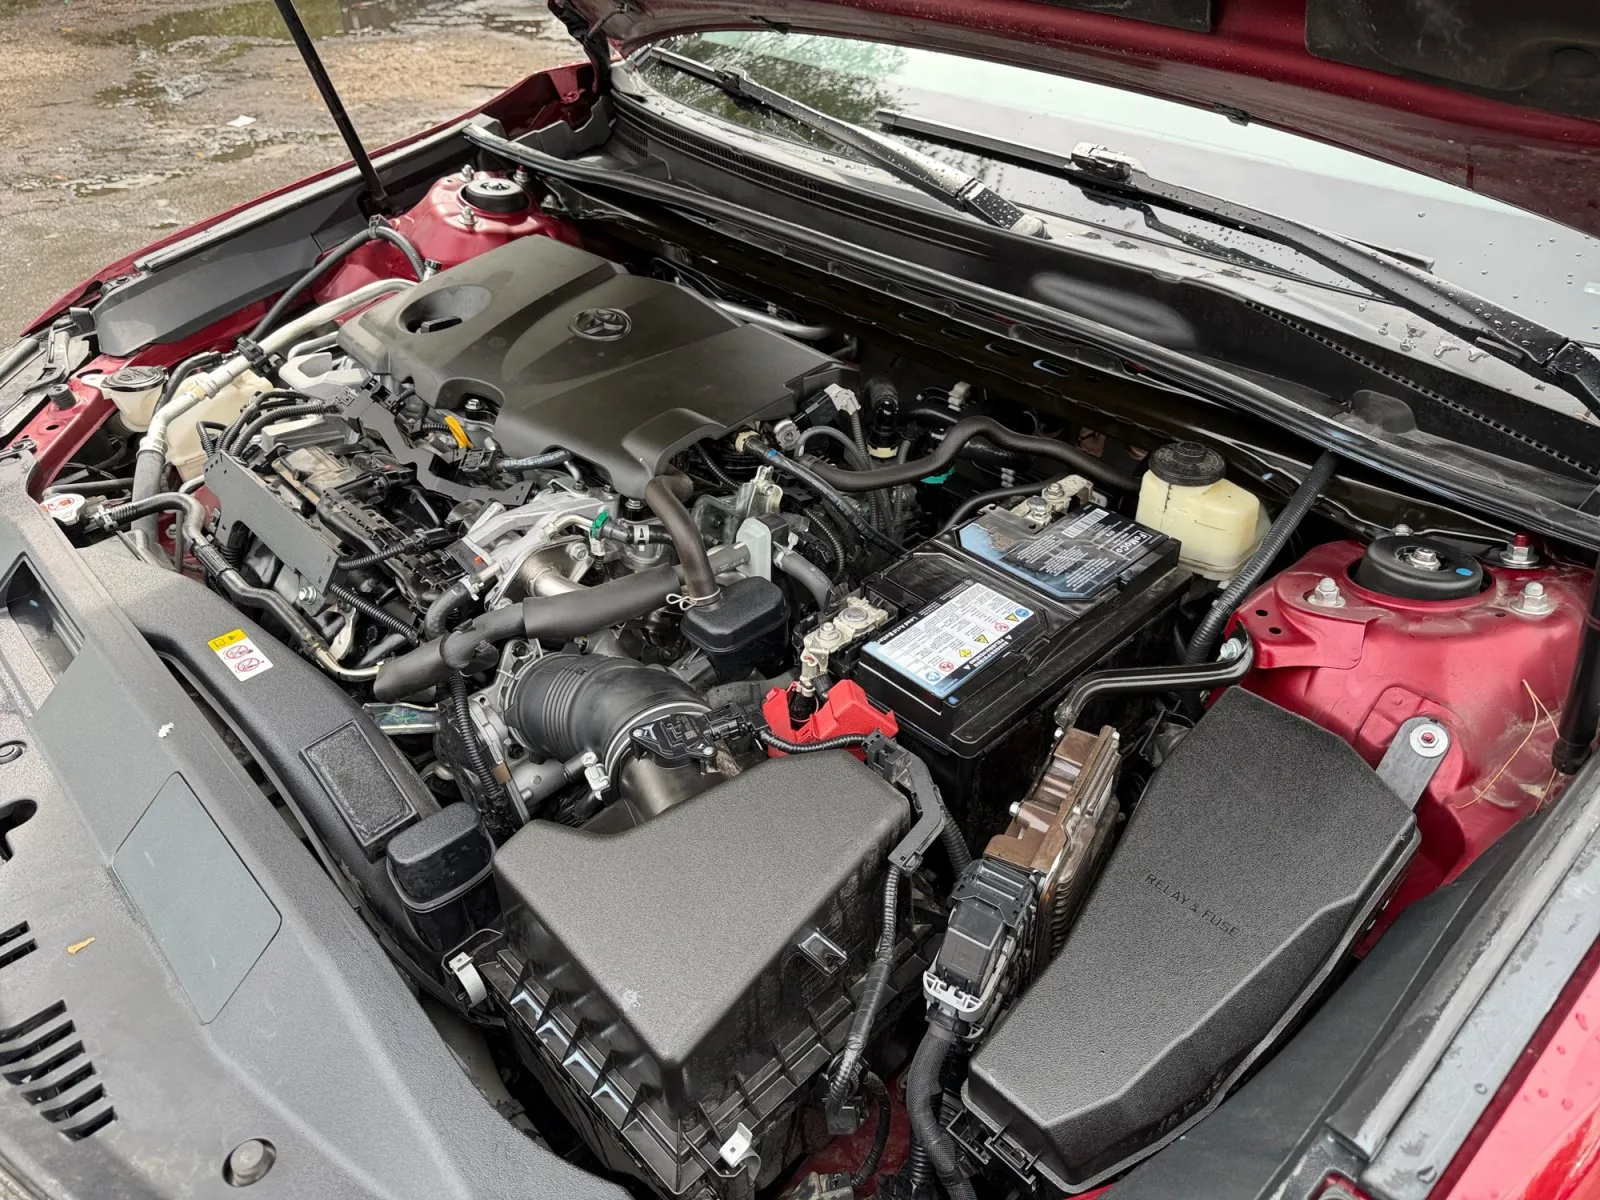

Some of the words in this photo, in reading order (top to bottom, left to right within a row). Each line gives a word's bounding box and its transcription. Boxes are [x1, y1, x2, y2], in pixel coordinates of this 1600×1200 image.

[1115, 532, 1148, 553] FoMoCo
[903, 616, 919, 627] Lead
[1144, 873, 1190, 905] RELAY
[1189, 903, 1200, 913] &
[1201, 910, 1240, 938] FUSE
